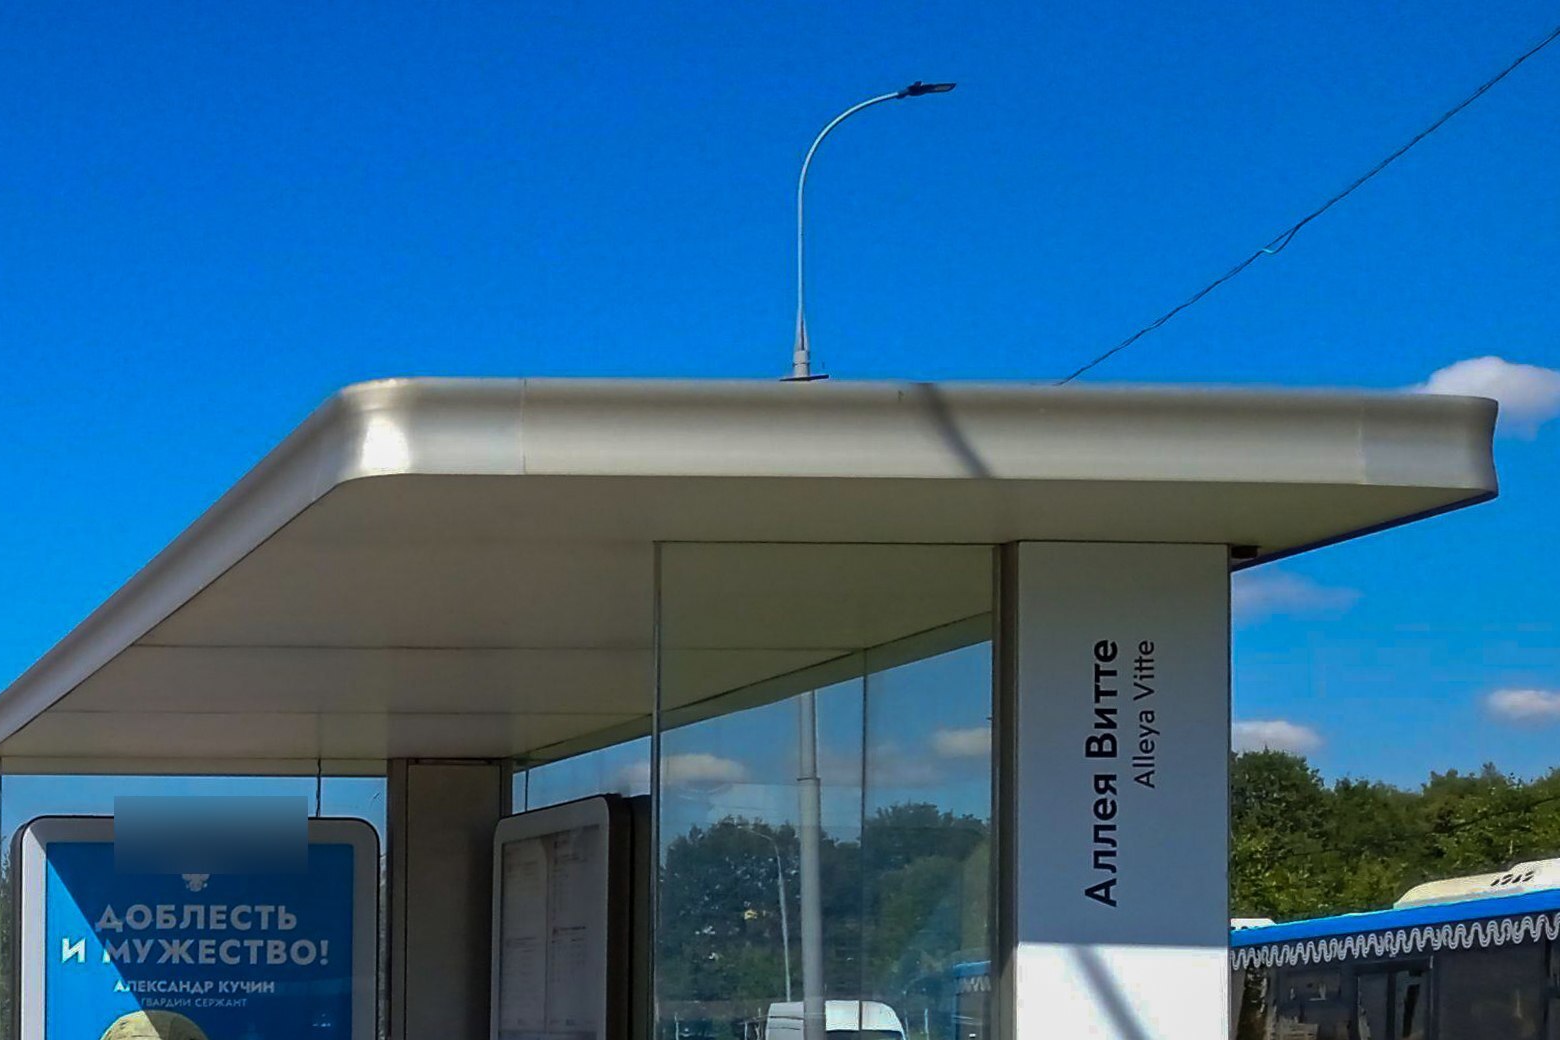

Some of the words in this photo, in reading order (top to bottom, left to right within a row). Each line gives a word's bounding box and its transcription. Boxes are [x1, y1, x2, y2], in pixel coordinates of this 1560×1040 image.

[1133, 639, 1156, 701] Vitte
[1085, 639, 1119, 759] Витте
[1132, 710, 1161, 789] Alleya
[1085, 774, 1118, 908] Аллея
[95, 904, 298, 933] ДОБЛЕСТЬ
[61, 937, 86, 964] И
[102, 938, 329, 966] МУЖЕСТВО!
[113, 979, 215, 995] АЛЕКСАНДР
[218, 980, 276, 994] КУЧИН
[140, 997, 192, 1008] ГВАРДИИ
[194, 997, 248, 1008] СЕРЖАНТ
